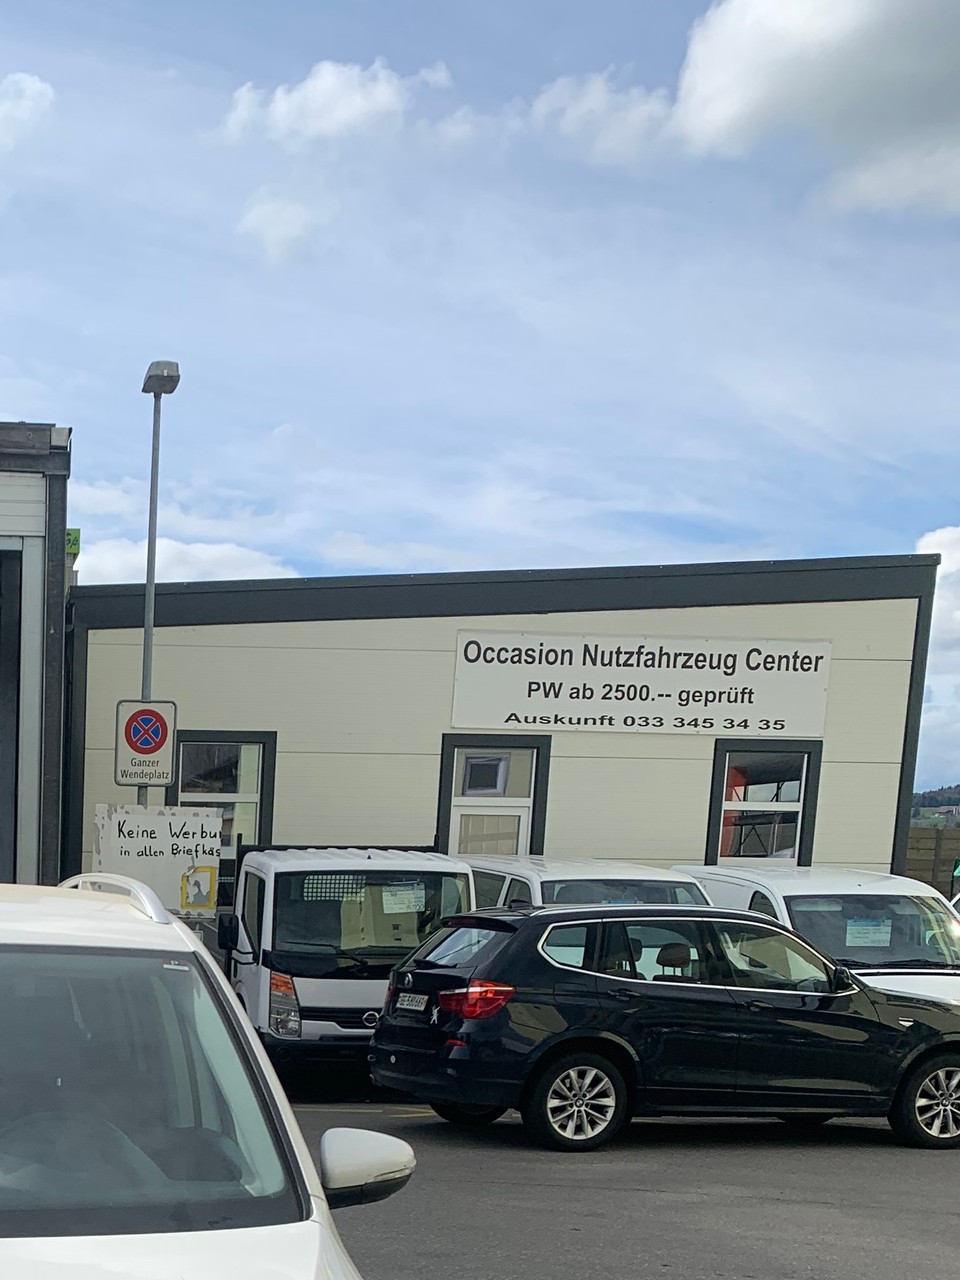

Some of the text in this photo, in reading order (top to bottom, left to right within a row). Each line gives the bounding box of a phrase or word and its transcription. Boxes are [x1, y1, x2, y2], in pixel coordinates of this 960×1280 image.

[463, 640, 824, 676] Occasion Nutzfahrzeug Center
[527, 681, 754, 707] PW ab 2500.-- geprüft
[503, 712, 786, 731] Auskunft 033 345 34 35
[130, 757, 160, 767] Ganzer
[120, 769, 170, 781] Wendeplatz
[117, 820, 158, 839] Keine
[120, 846, 131, 857] in
[136, 846, 165, 857] allen
